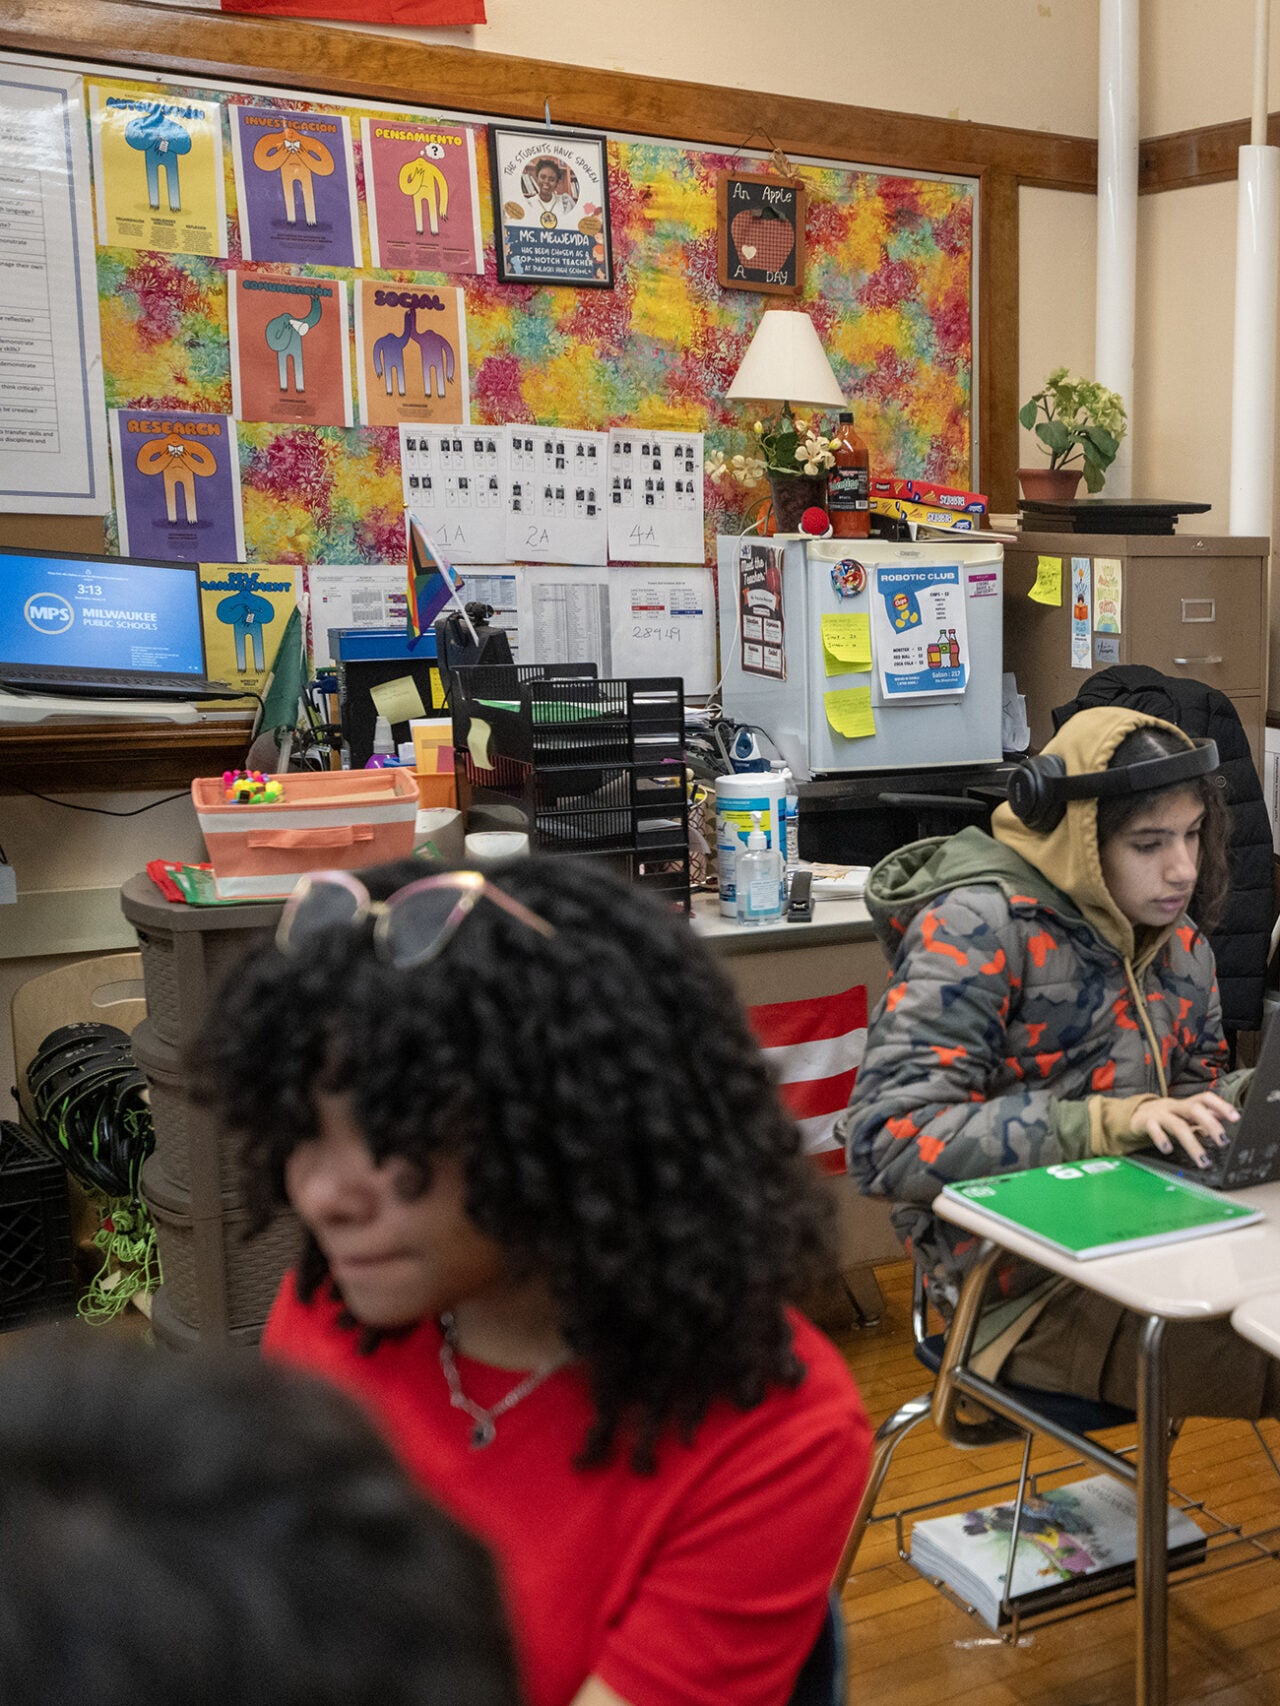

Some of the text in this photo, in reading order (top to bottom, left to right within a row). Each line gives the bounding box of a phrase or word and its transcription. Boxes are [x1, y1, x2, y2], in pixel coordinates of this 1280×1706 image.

[244, 116, 337, 133] INVESTIGACIÓN
[375, 127, 462, 146] PENSAMIENTO
[431, 145, 439, 156] ?
[504, 143, 600, 184] THE STUDENTS HAVE SPOKEN
[732, 182, 793, 204] An Apple
[519, 230, 538, 243] MS.
[521, 246, 533, 254] HAS
[534, 247, 550, 256] BEEN
[551, 248, 574, 257] CHOSEN
[517, 255, 594, 267] TOP-NOTCH TEACHER
[734, 264, 788, 286] A DAY
[242, 280, 333, 298] COMUNICACIÓN
[375, 290, 446, 311] SOCIAL
[127, 418, 222, 436] RESEARCH
[526, 525, 550, 546] 2A
[629, 524, 656, 542] 4A
[881, 572, 956, 582] ROBOTIC CLUB
[77, 584, 103, 596] 3:13
[30, 606, 70, 622] MPS
[82, 607, 158, 622] MILWAUKEE
[83, 618, 158, 631] PUBLIC SCHOOLS
